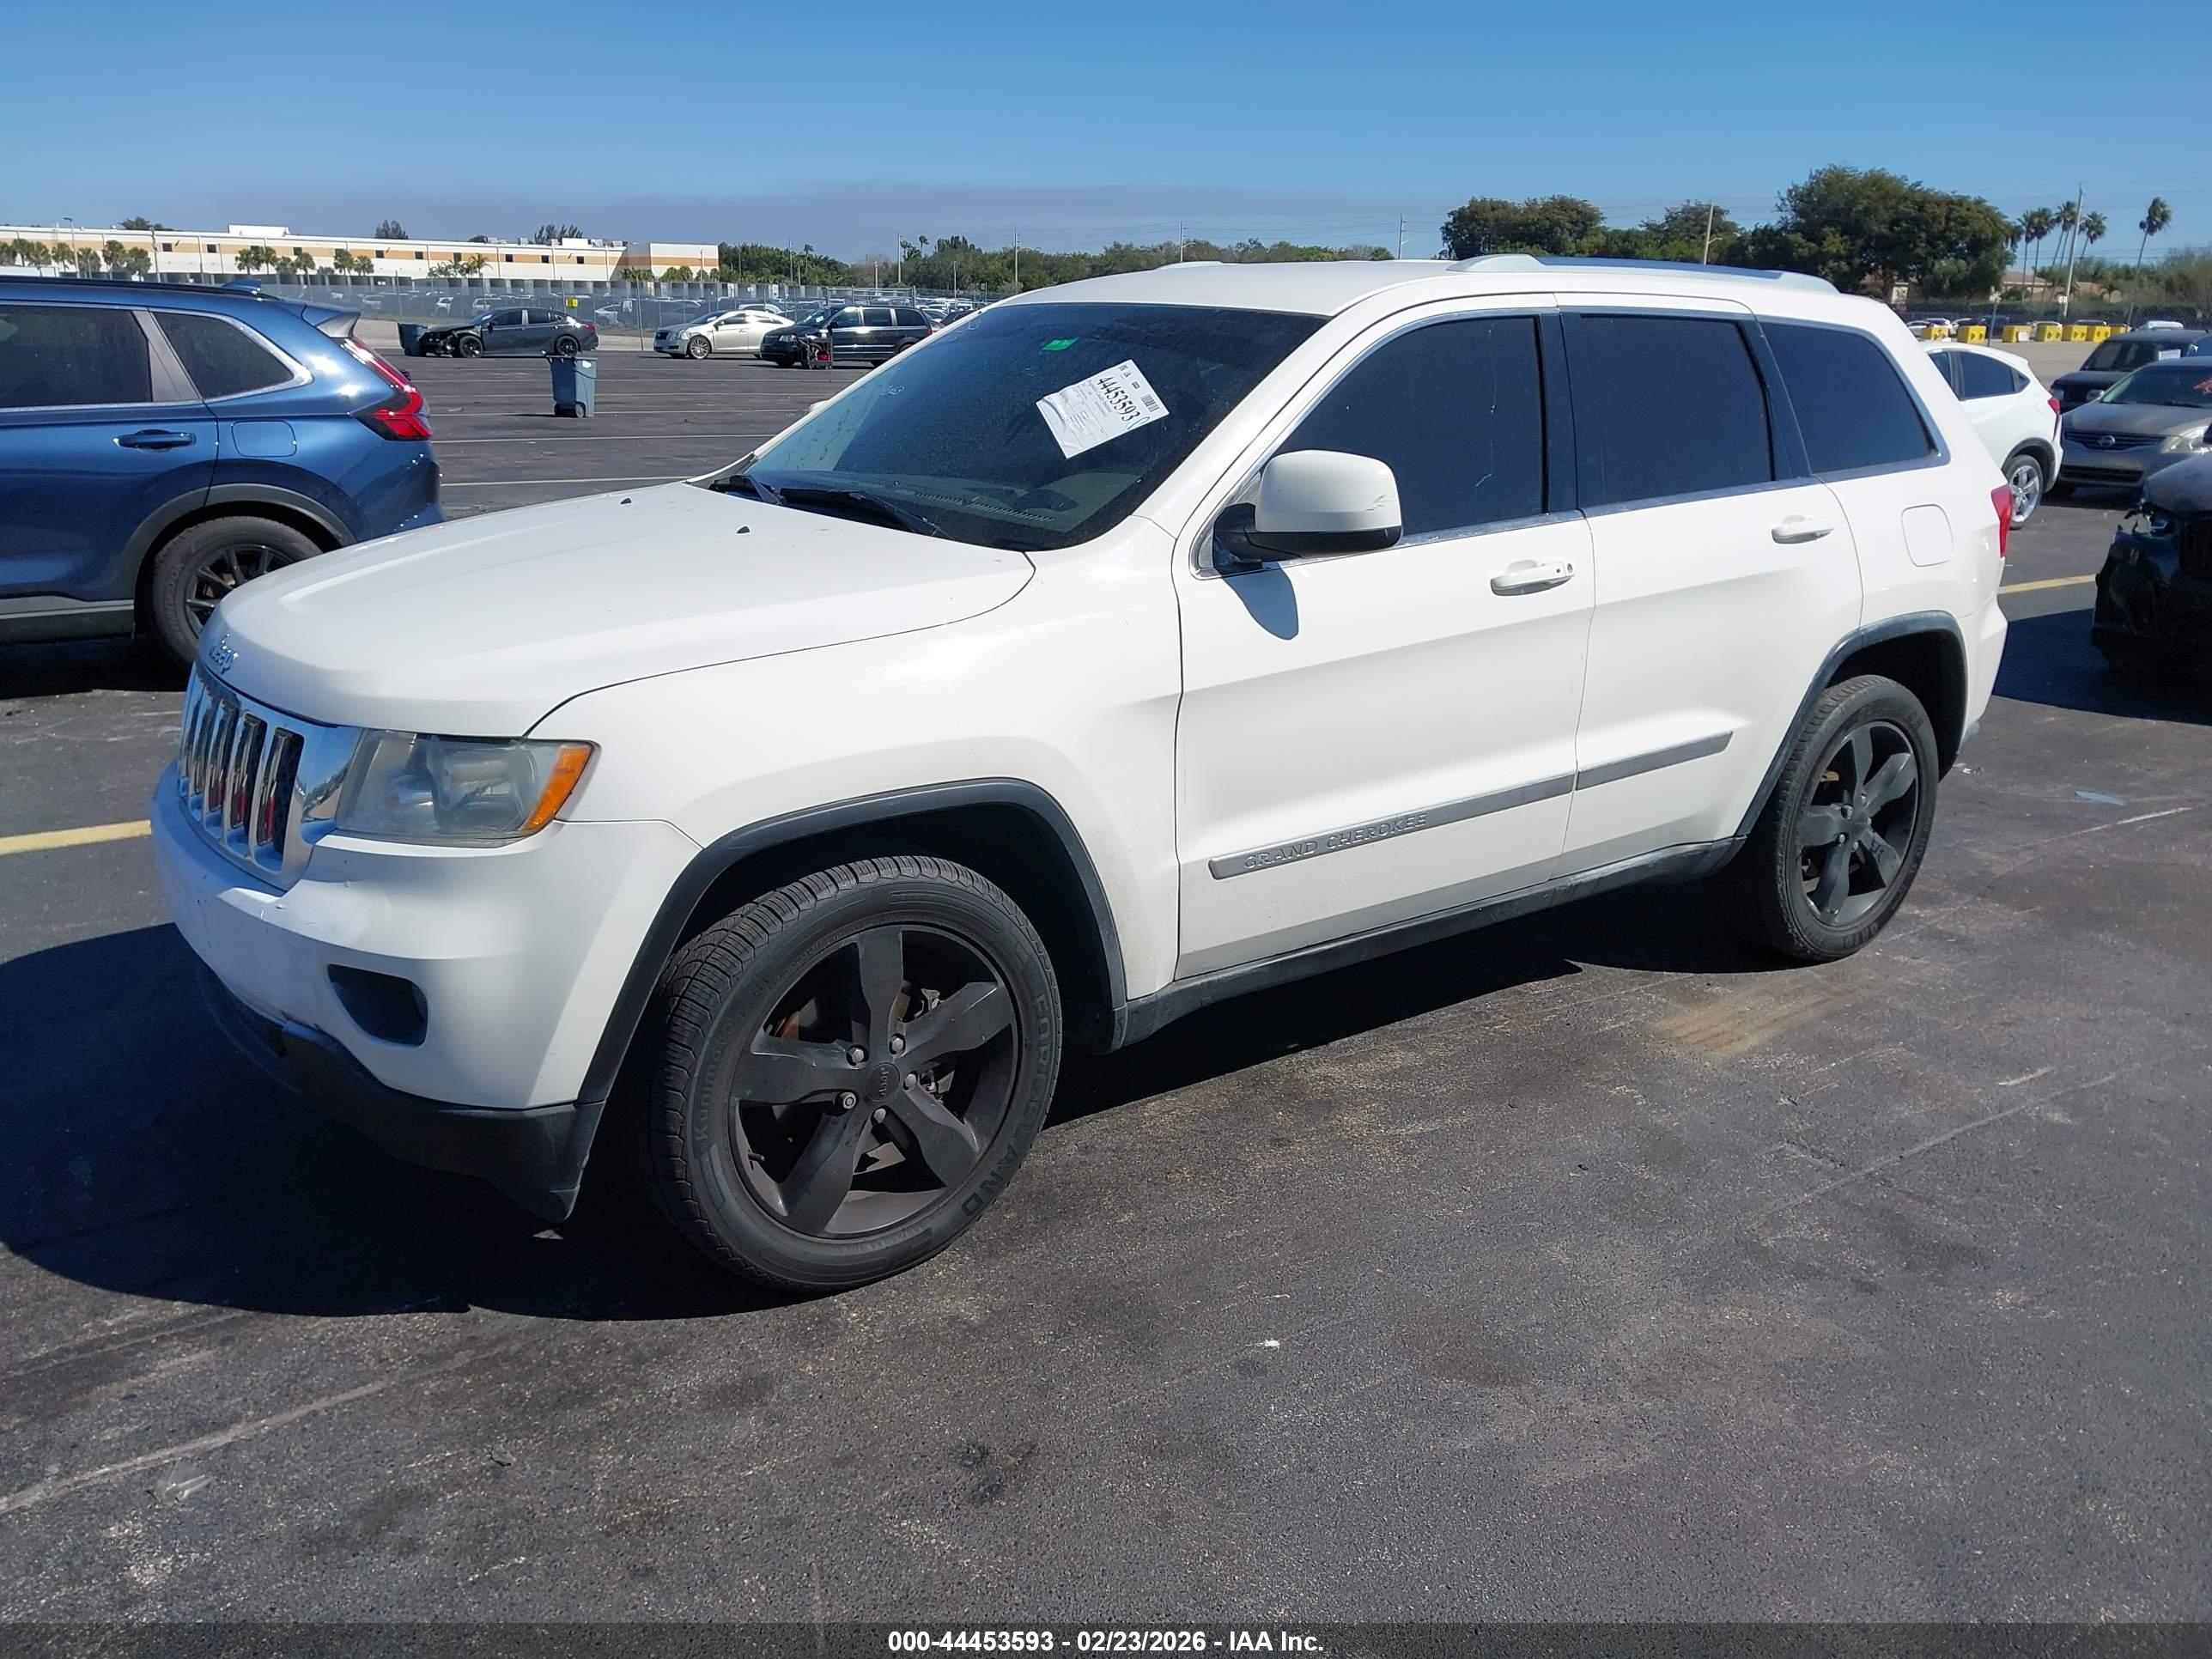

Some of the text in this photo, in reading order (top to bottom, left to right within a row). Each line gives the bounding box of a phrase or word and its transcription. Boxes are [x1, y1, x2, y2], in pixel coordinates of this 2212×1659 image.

[1097, 376, 1141, 422] 44453593
[1243, 813, 1429, 870] GRAND CHEROKEE
[878, 1066, 890, 1098] Jeep
